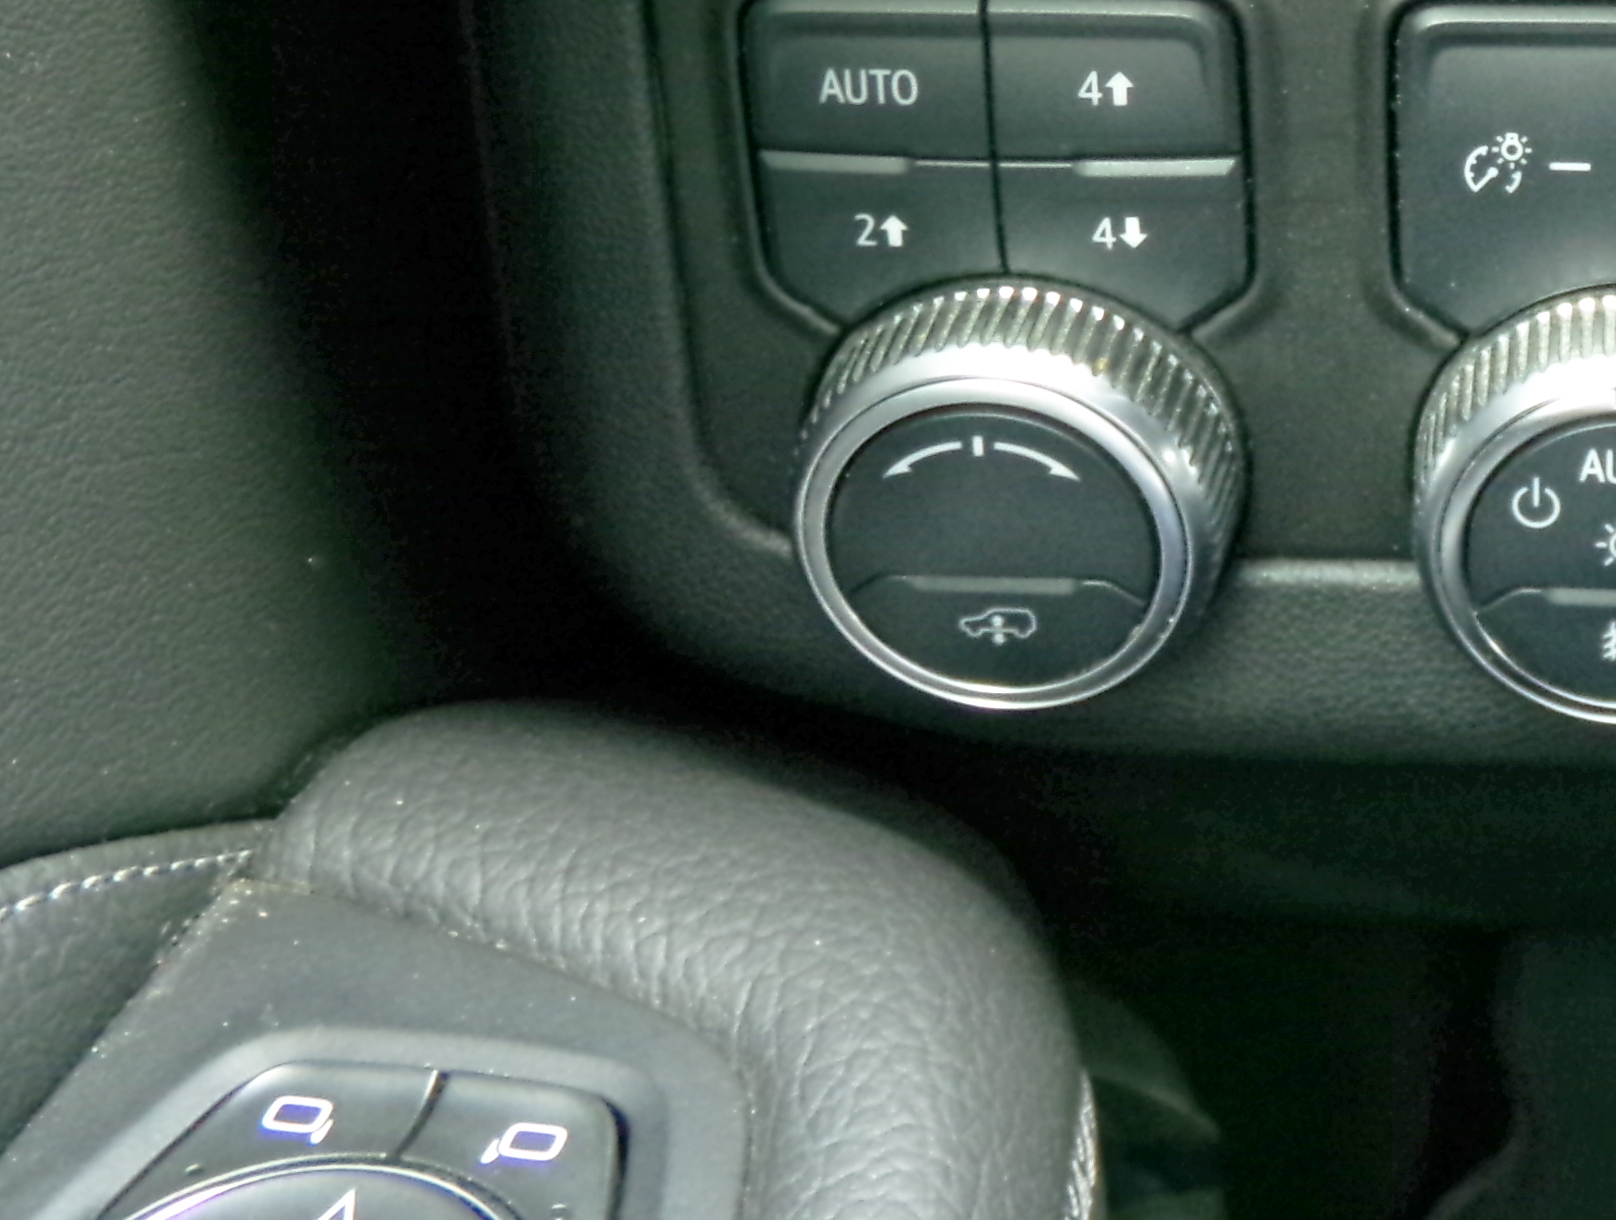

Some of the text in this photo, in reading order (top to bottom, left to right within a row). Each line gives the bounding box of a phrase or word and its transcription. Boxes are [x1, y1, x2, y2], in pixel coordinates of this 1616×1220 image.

[818, 67, 920, 107] AUTO
[1077, 70, 1103, 108] 4
[854, 213, 879, 248] 2
[1091, 216, 1117, 251] 4
